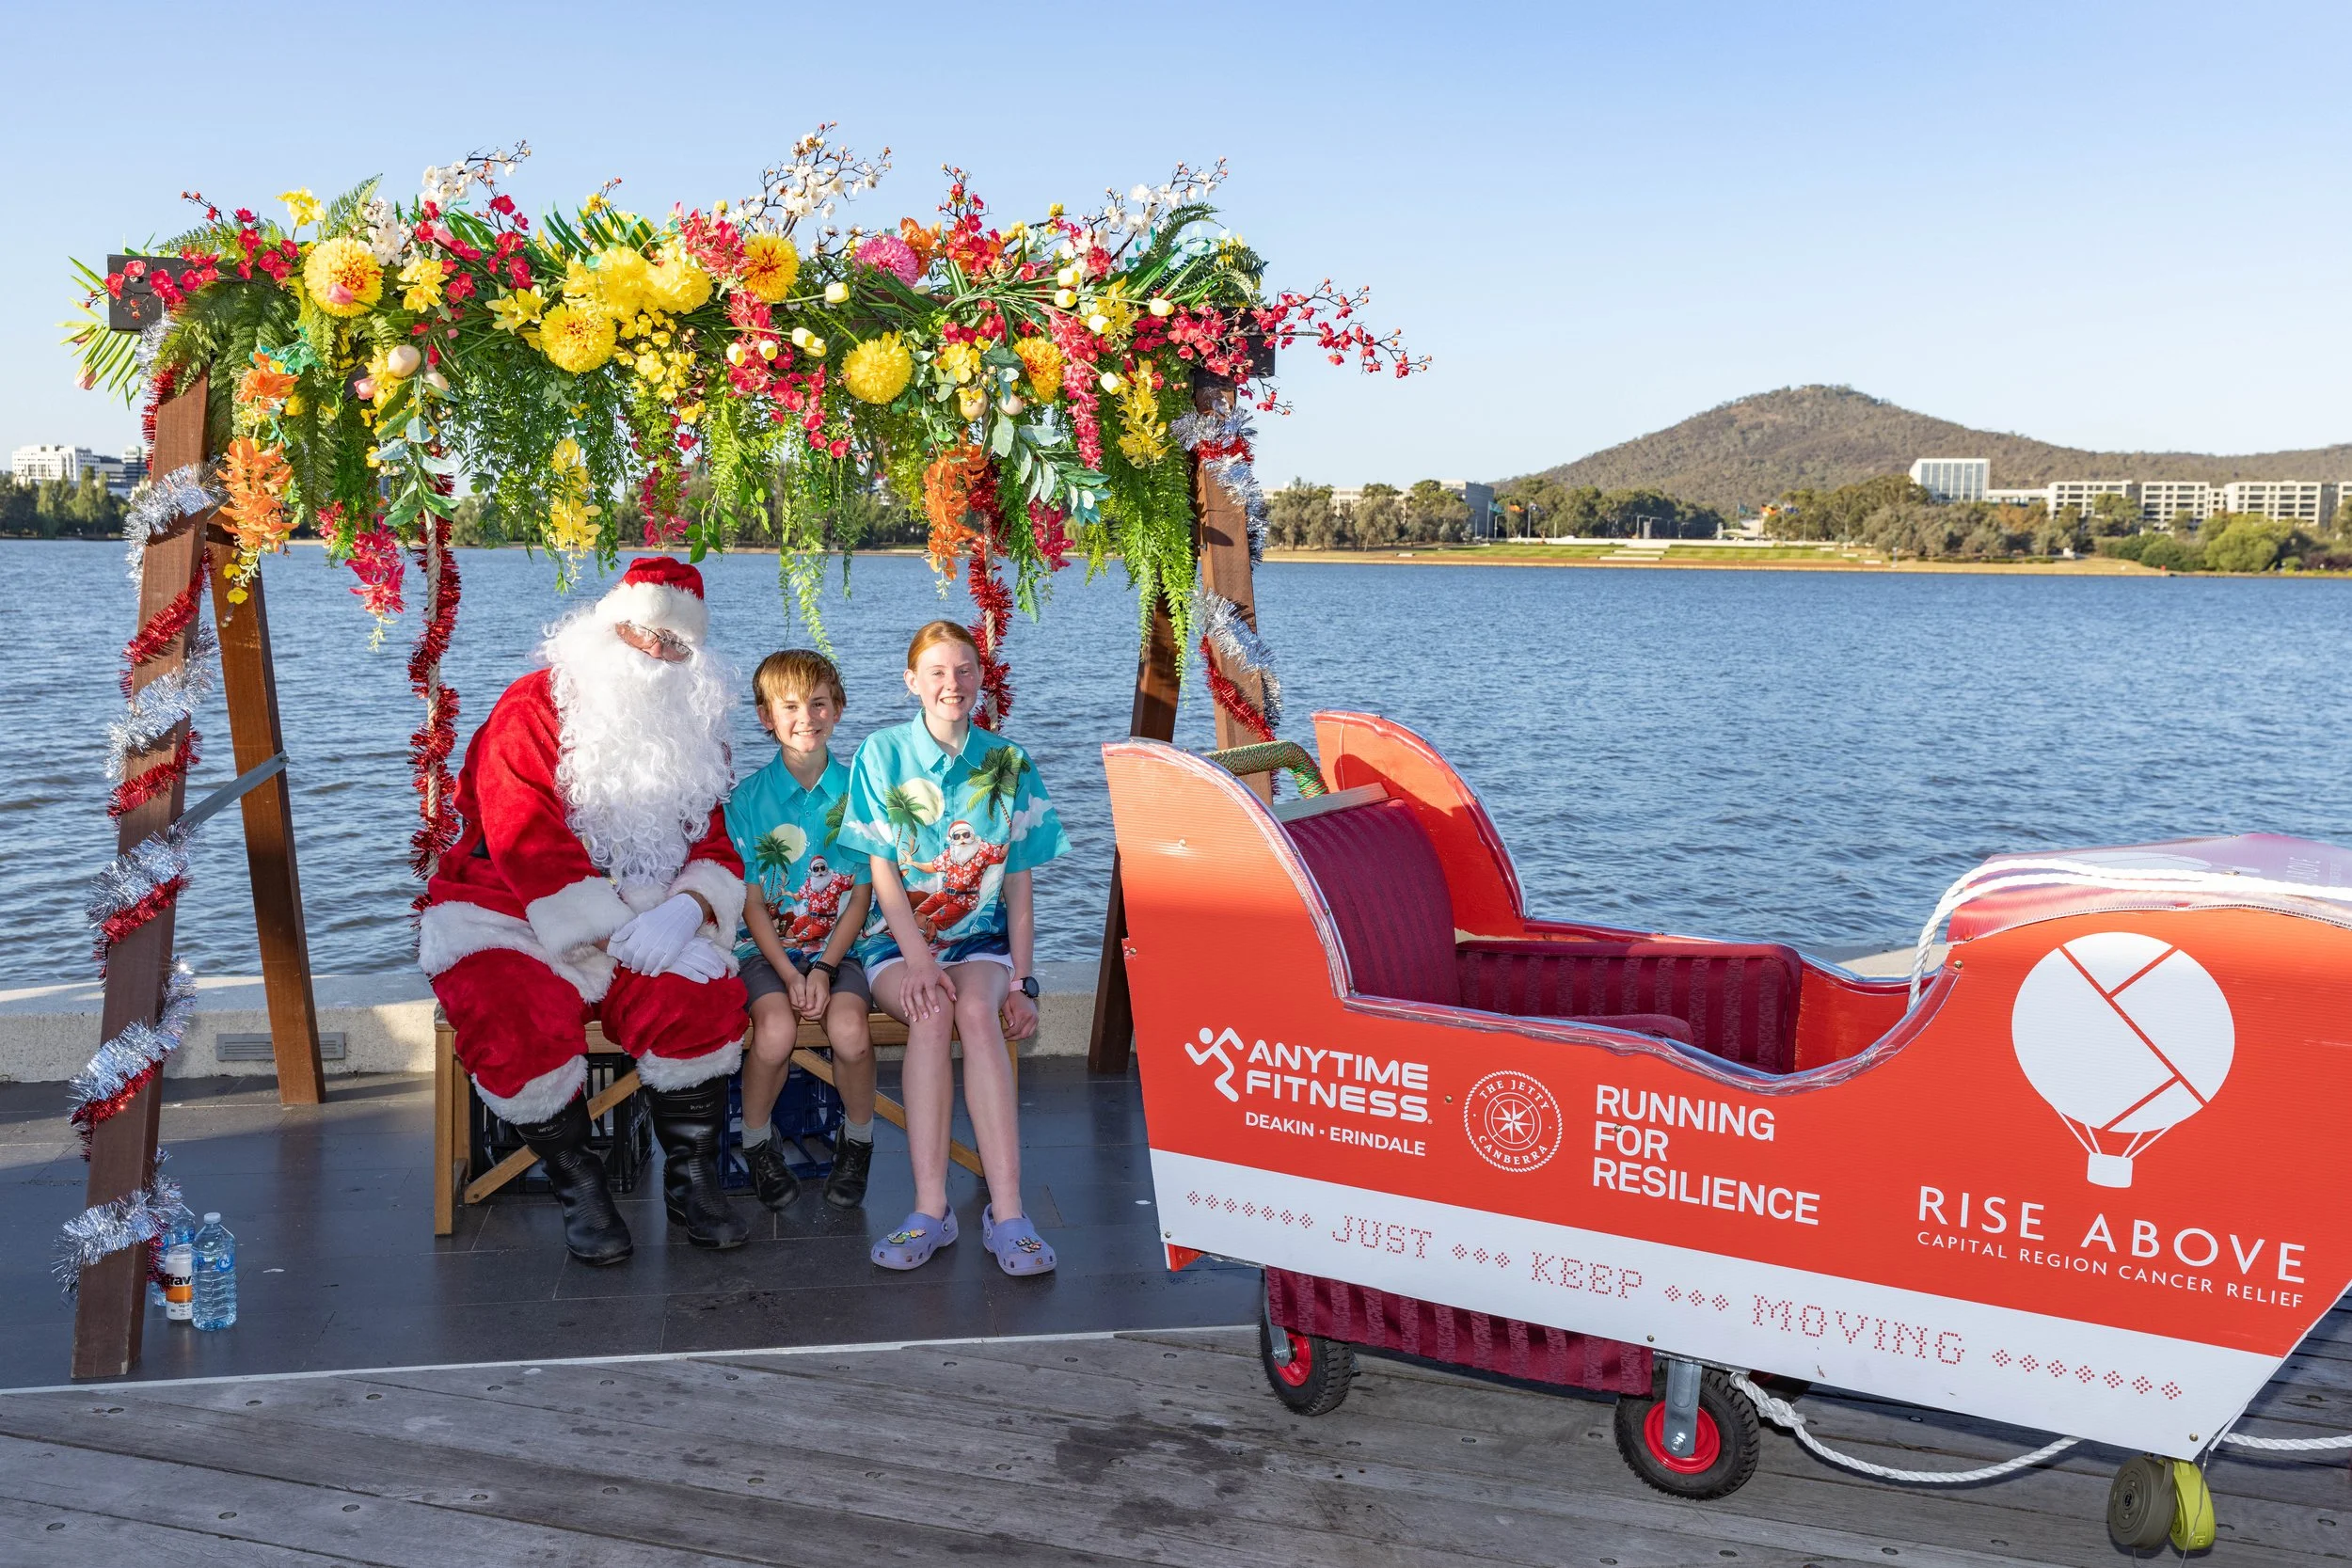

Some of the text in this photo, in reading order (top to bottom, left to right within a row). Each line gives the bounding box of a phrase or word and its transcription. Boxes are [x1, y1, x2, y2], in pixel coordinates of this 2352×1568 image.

[1247, 1038, 1429, 1091] ANYTIME
[1246, 1069, 1429, 1123] FITNESS
[1479, 1079, 1549, 1110] THE JETTY
[1596, 1084, 1775, 1142] RUNNING
[1245, 1111, 1426, 1157] DEAKIN ERINDALE
[1478, 1135, 1549, 1165] CANBERRA
[1594, 1120, 1669, 1162] FOR
[1593, 1157, 1820, 1226] RESILIENCE
[1918, 1185, 2306, 1284] RISE ABOVE
[1332, 1215, 1965, 1365] JUST KEEP MOVING
[1917, 1231, 2303, 1308] CAPITAL REGION CANCER RELIEF
